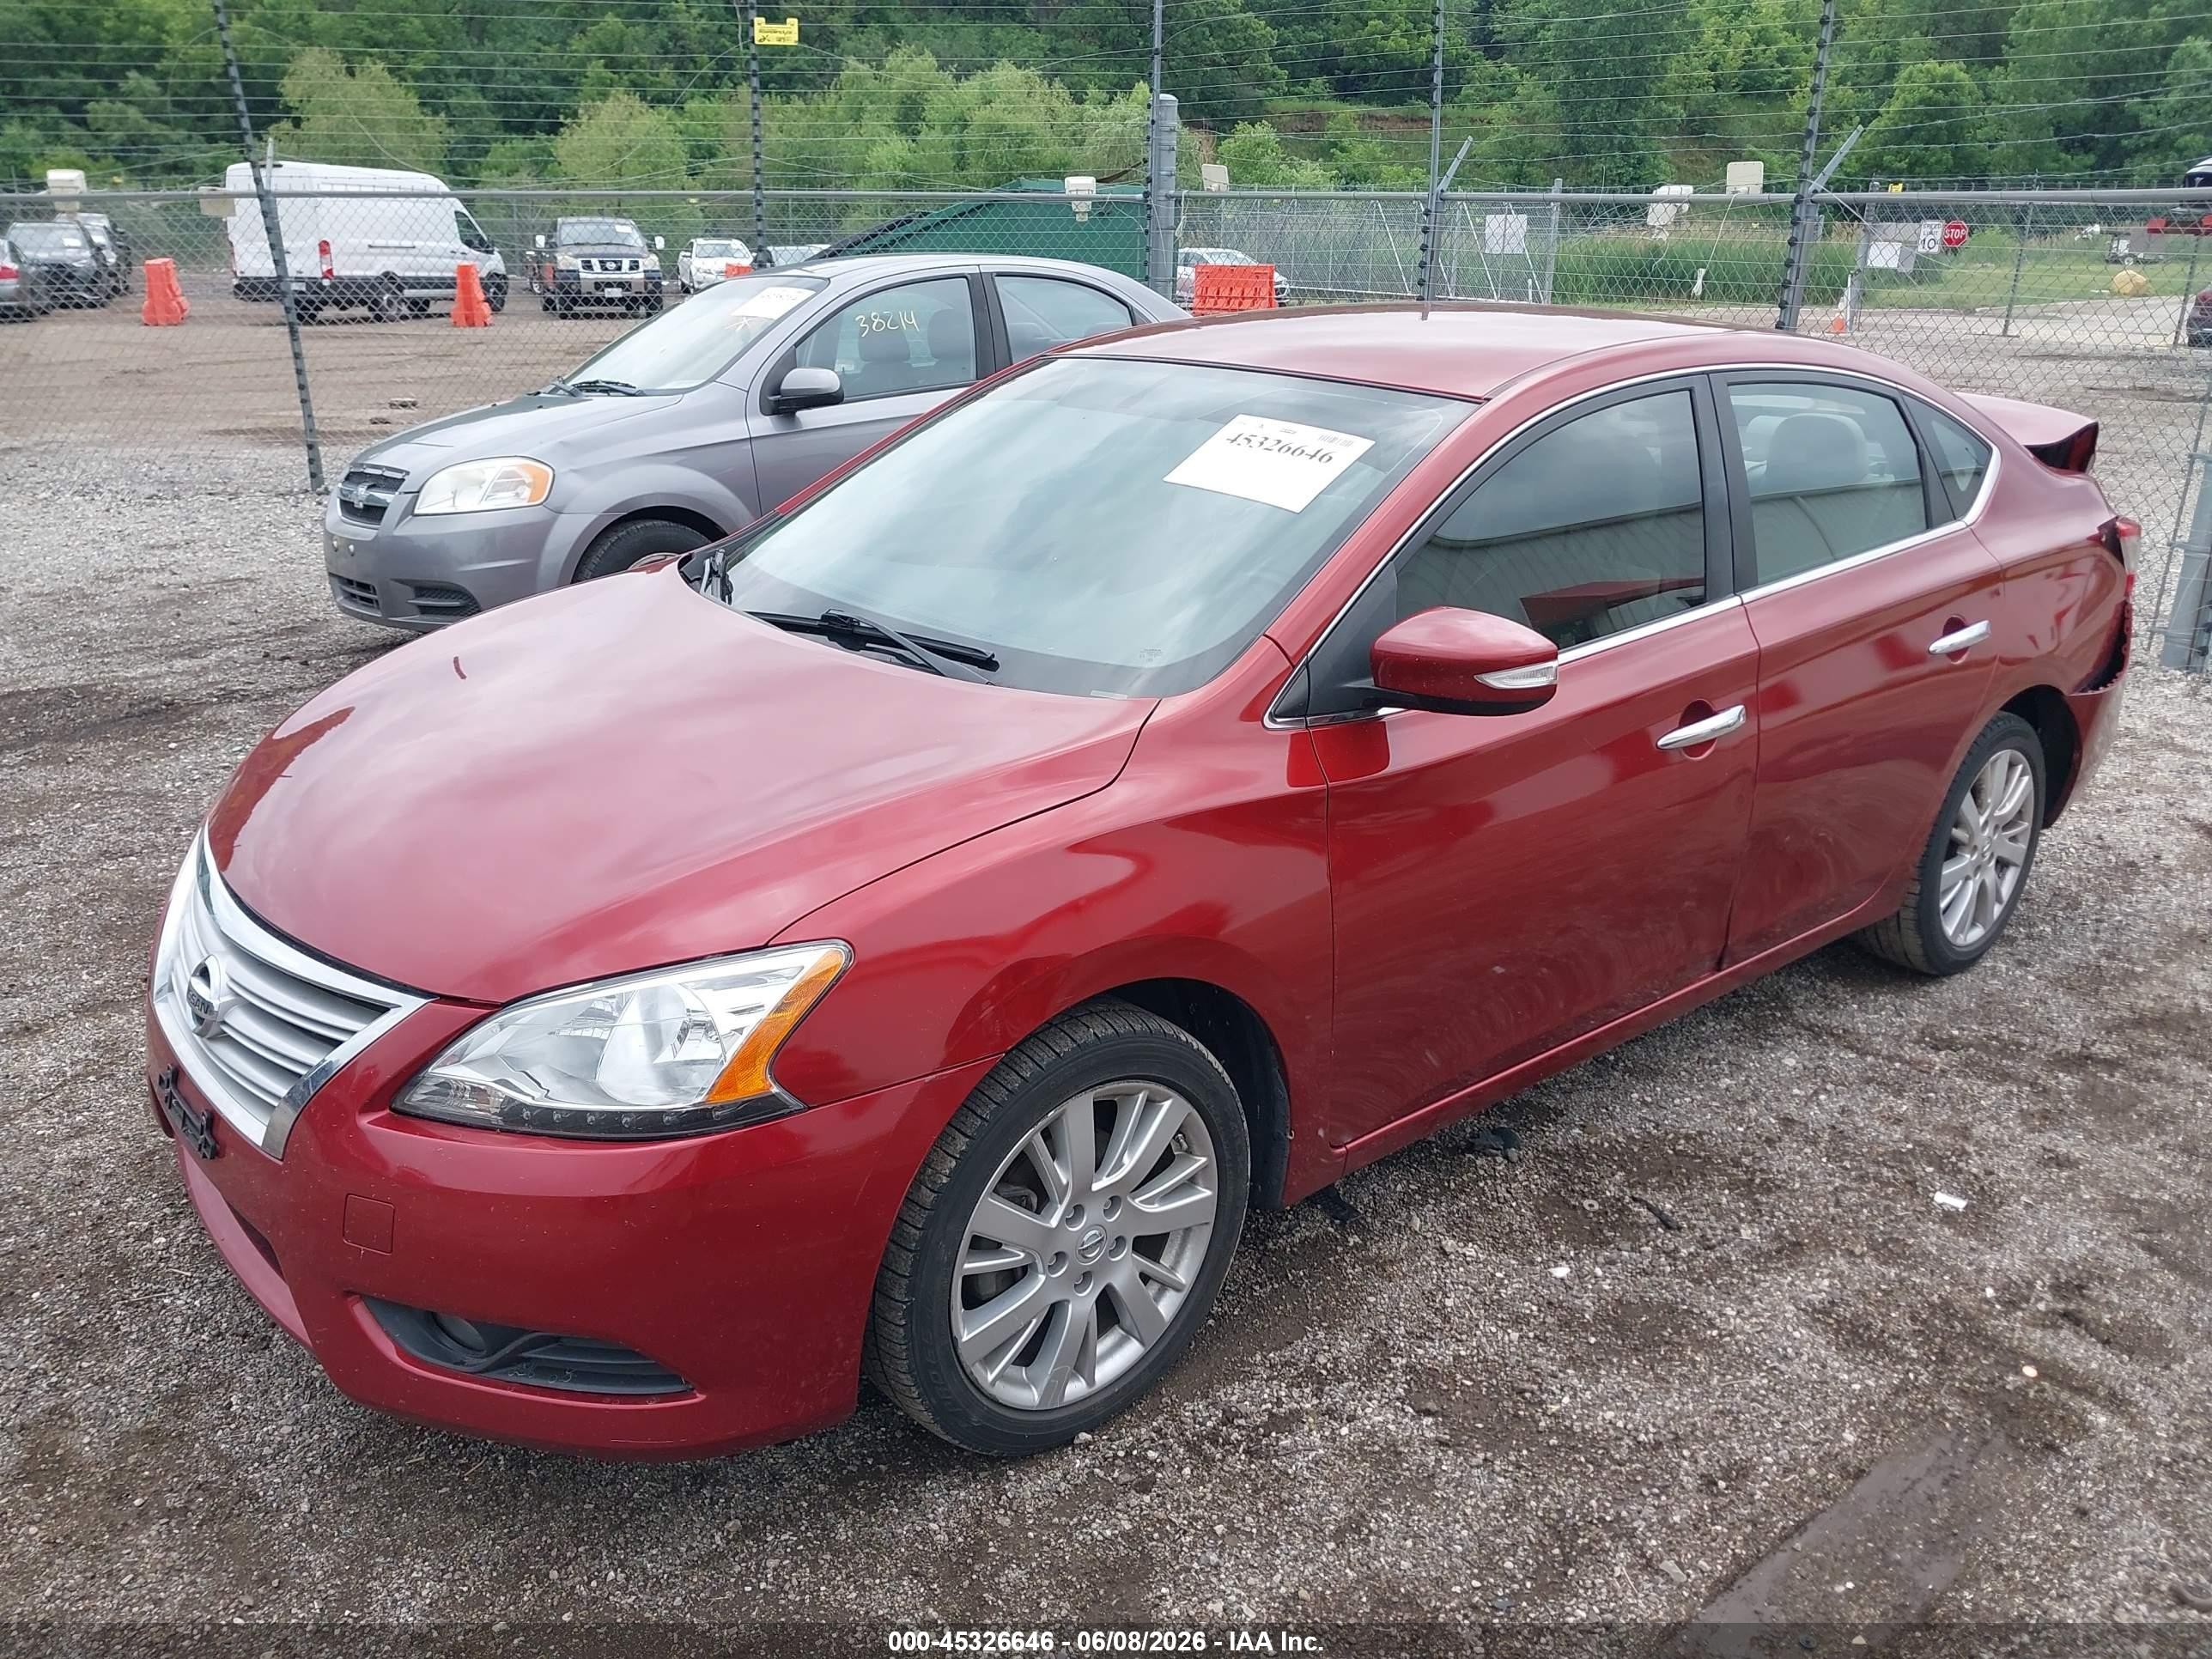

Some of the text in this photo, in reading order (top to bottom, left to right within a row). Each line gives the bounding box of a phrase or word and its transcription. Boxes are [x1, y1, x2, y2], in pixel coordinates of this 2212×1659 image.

[1944, 228, 1966, 240] STOP
[1921, 238, 1936, 250] 10
[855, 310, 920, 337] 38214
[1226, 433, 1334, 464] 45326646
